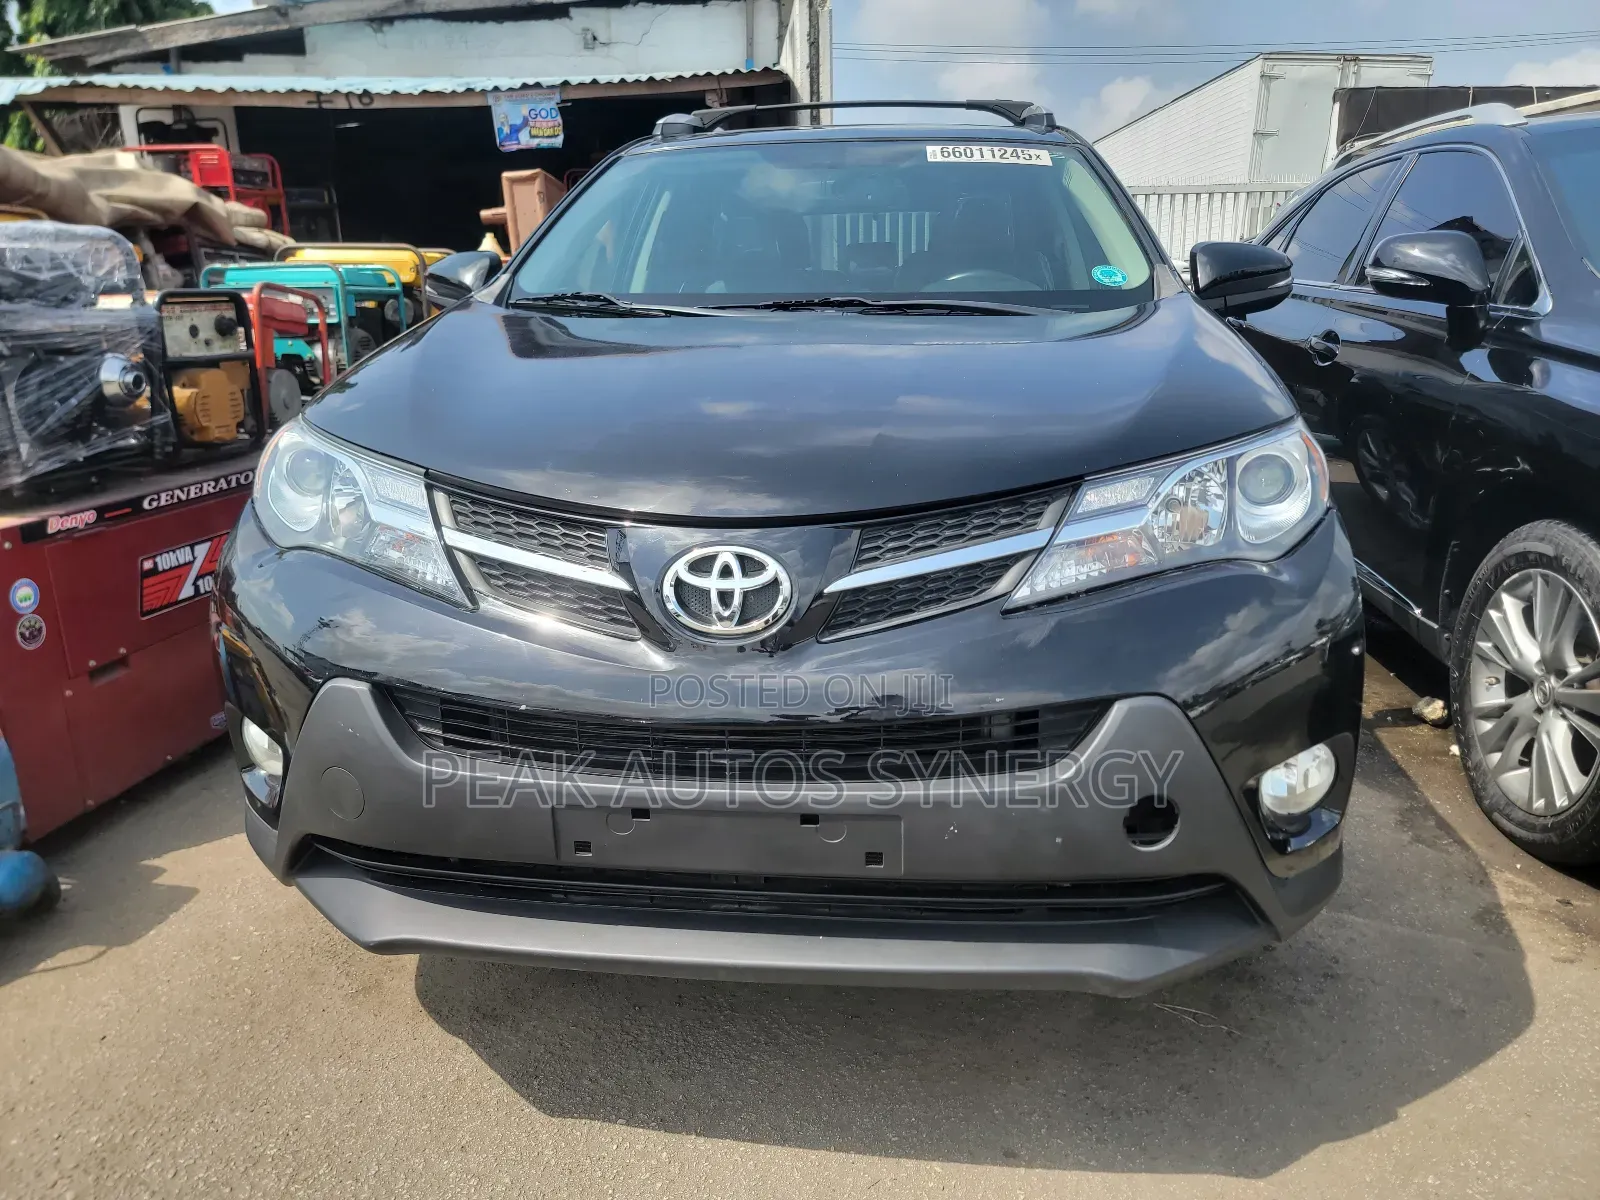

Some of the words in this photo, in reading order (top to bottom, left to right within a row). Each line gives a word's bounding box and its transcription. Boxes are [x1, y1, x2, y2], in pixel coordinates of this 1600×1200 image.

[528, 107, 559, 120] GOD
[47, 509, 97, 534] Denyo
[142, 470, 254, 511] GENERATO
